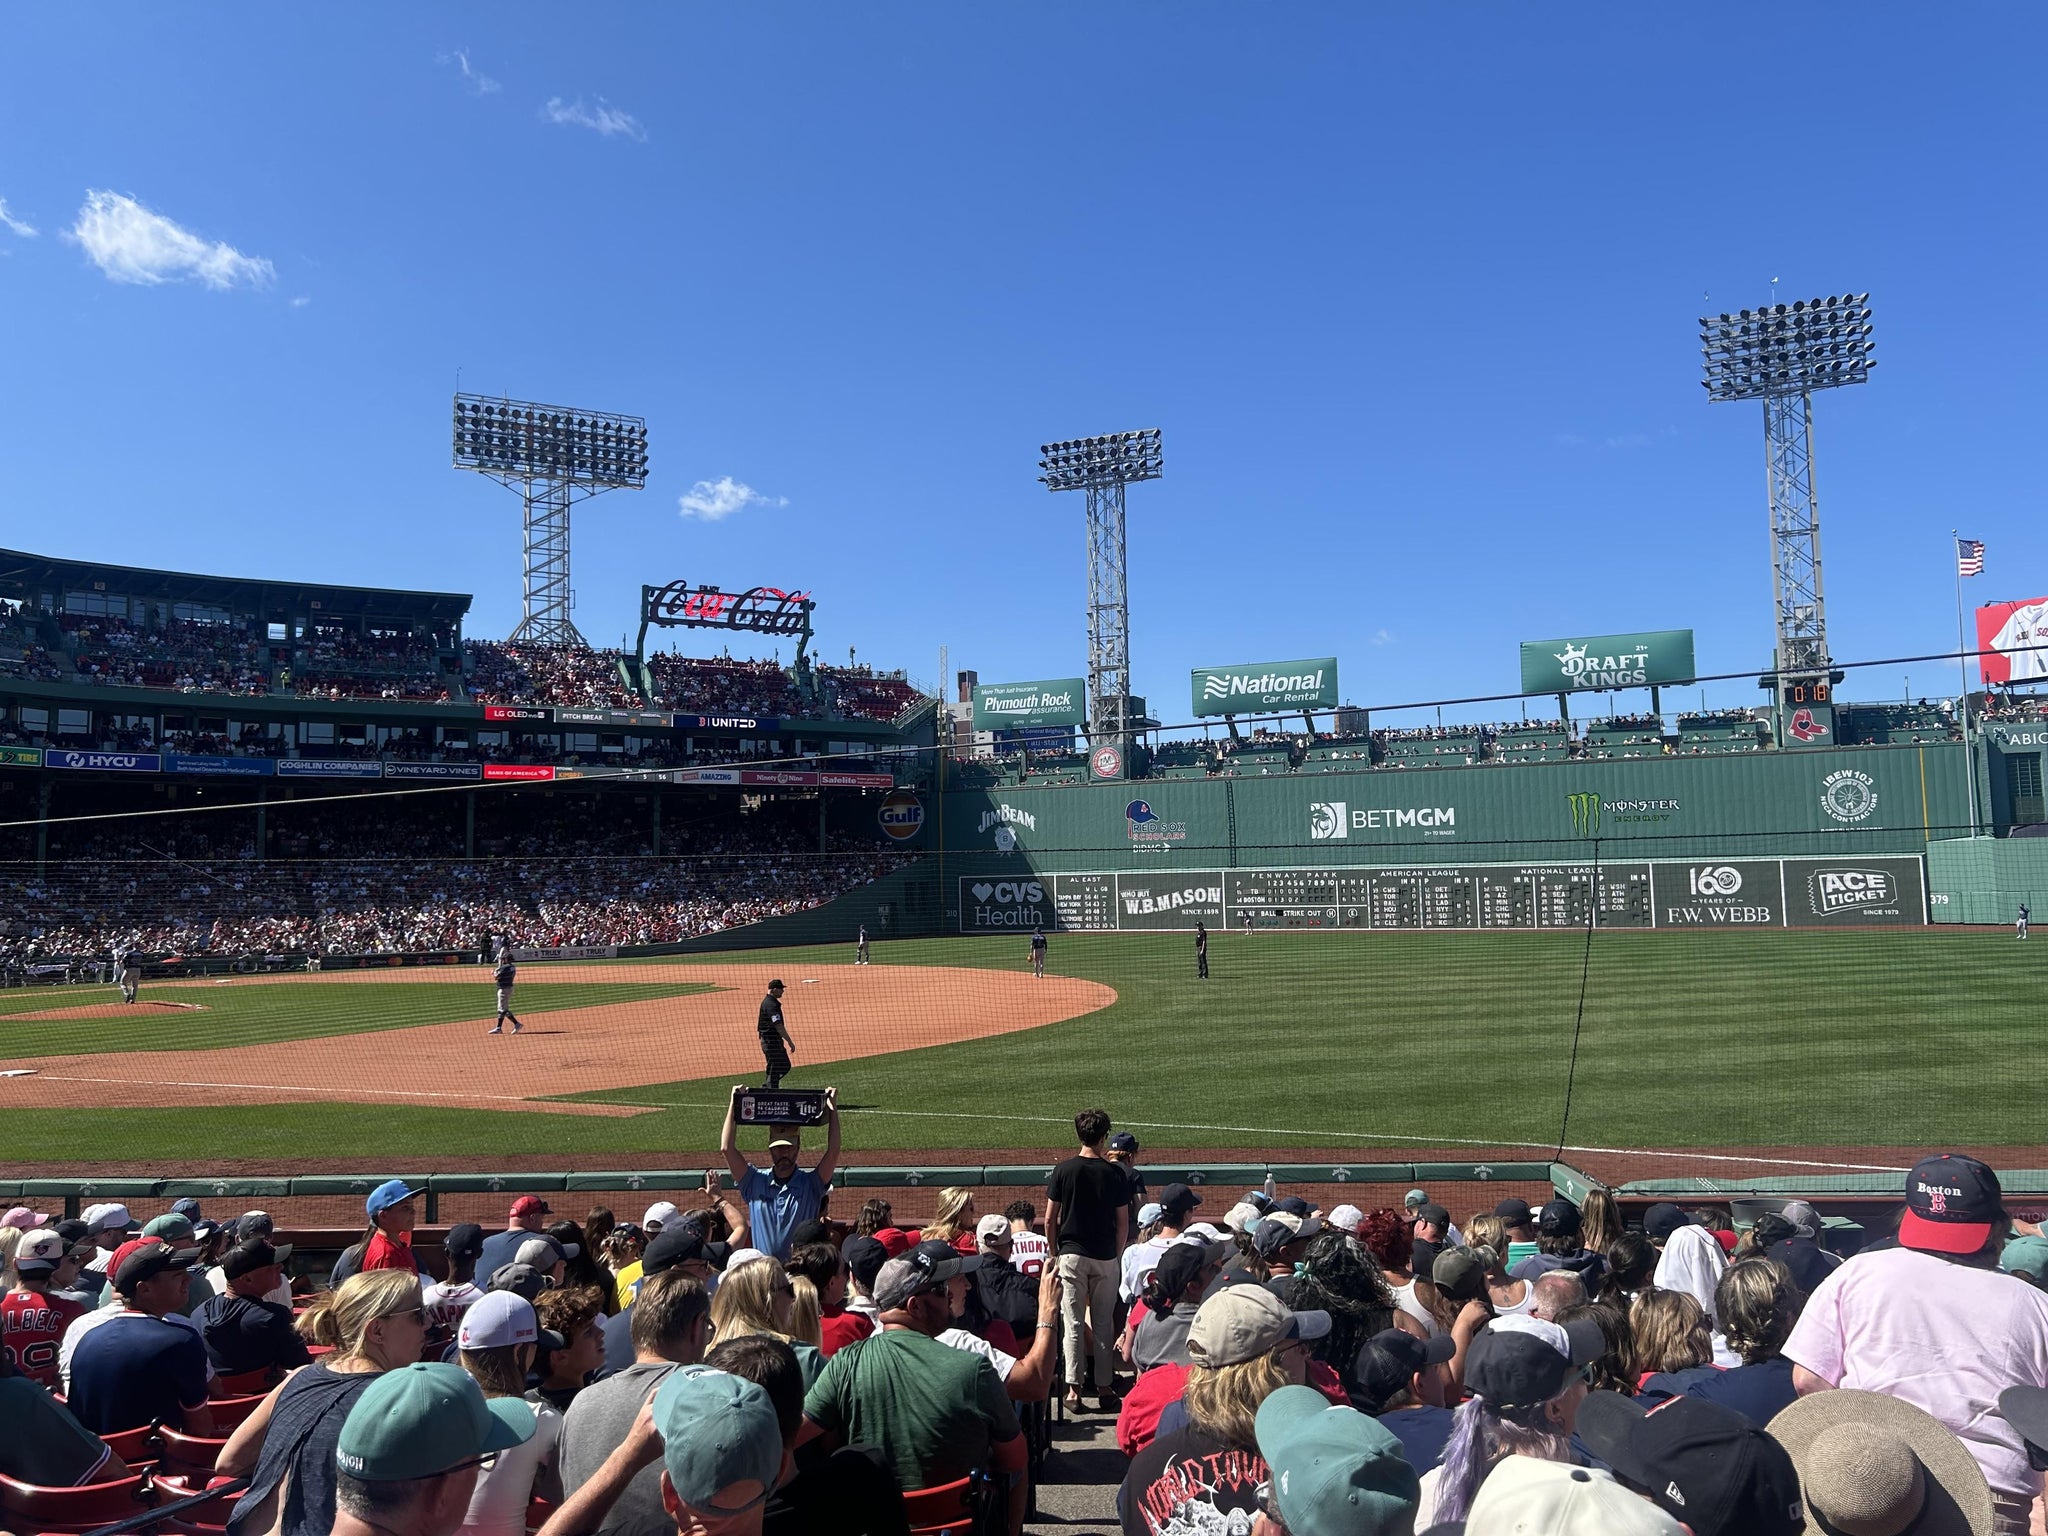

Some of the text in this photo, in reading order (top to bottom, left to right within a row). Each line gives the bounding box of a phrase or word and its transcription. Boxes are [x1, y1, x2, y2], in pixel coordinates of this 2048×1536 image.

[1561, 654, 1648, 676] DRAFT
[1573, 670, 1646, 687] KINGS
[985, 692, 1071, 710] Plymouth Rock
[1263, 692, 1318, 703] Car Rental
[712, 718, 756, 728] UNITED
[18, 754, 38, 762] TIRE
[90, 756, 136, 767] HYCU
[822, 776, 856, 784] Safelite
[1823, 770, 1873, 787] IBEW 103
[1604, 799, 1680, 812] MONSTER
[1832, 793, 1877, 822] CONTRACTORS
[880, 807, 921, 823] Gulf
[1001, 804, 1036, 831] BEAM
[1352, 808, 1454, 828] BETMGM
[1133, 823, 1185, 832] RED SOX
[1133, 832, 1186, 840] SCHOLARS
[1690, 867, 1742, 895] 160
[1826, 872, 1885, 892] ACE
[995, 882, 1043, 903] CVS
[1121, 890, 1136, 898] WHO
[1828, 890, 1887, 906] TICKET
[1930, 895, 1948, 904] 379
[975, 906, 1043, 926] Health
[1709, 907, 1770, 922] WEBB
[800, 1101, 816, 1115] Lite
[1917, 1182, 1962, 1196] Boston
[1930, 1192, 1946, 1213] B
[1012, 1241, 1049, 1255] THONY
